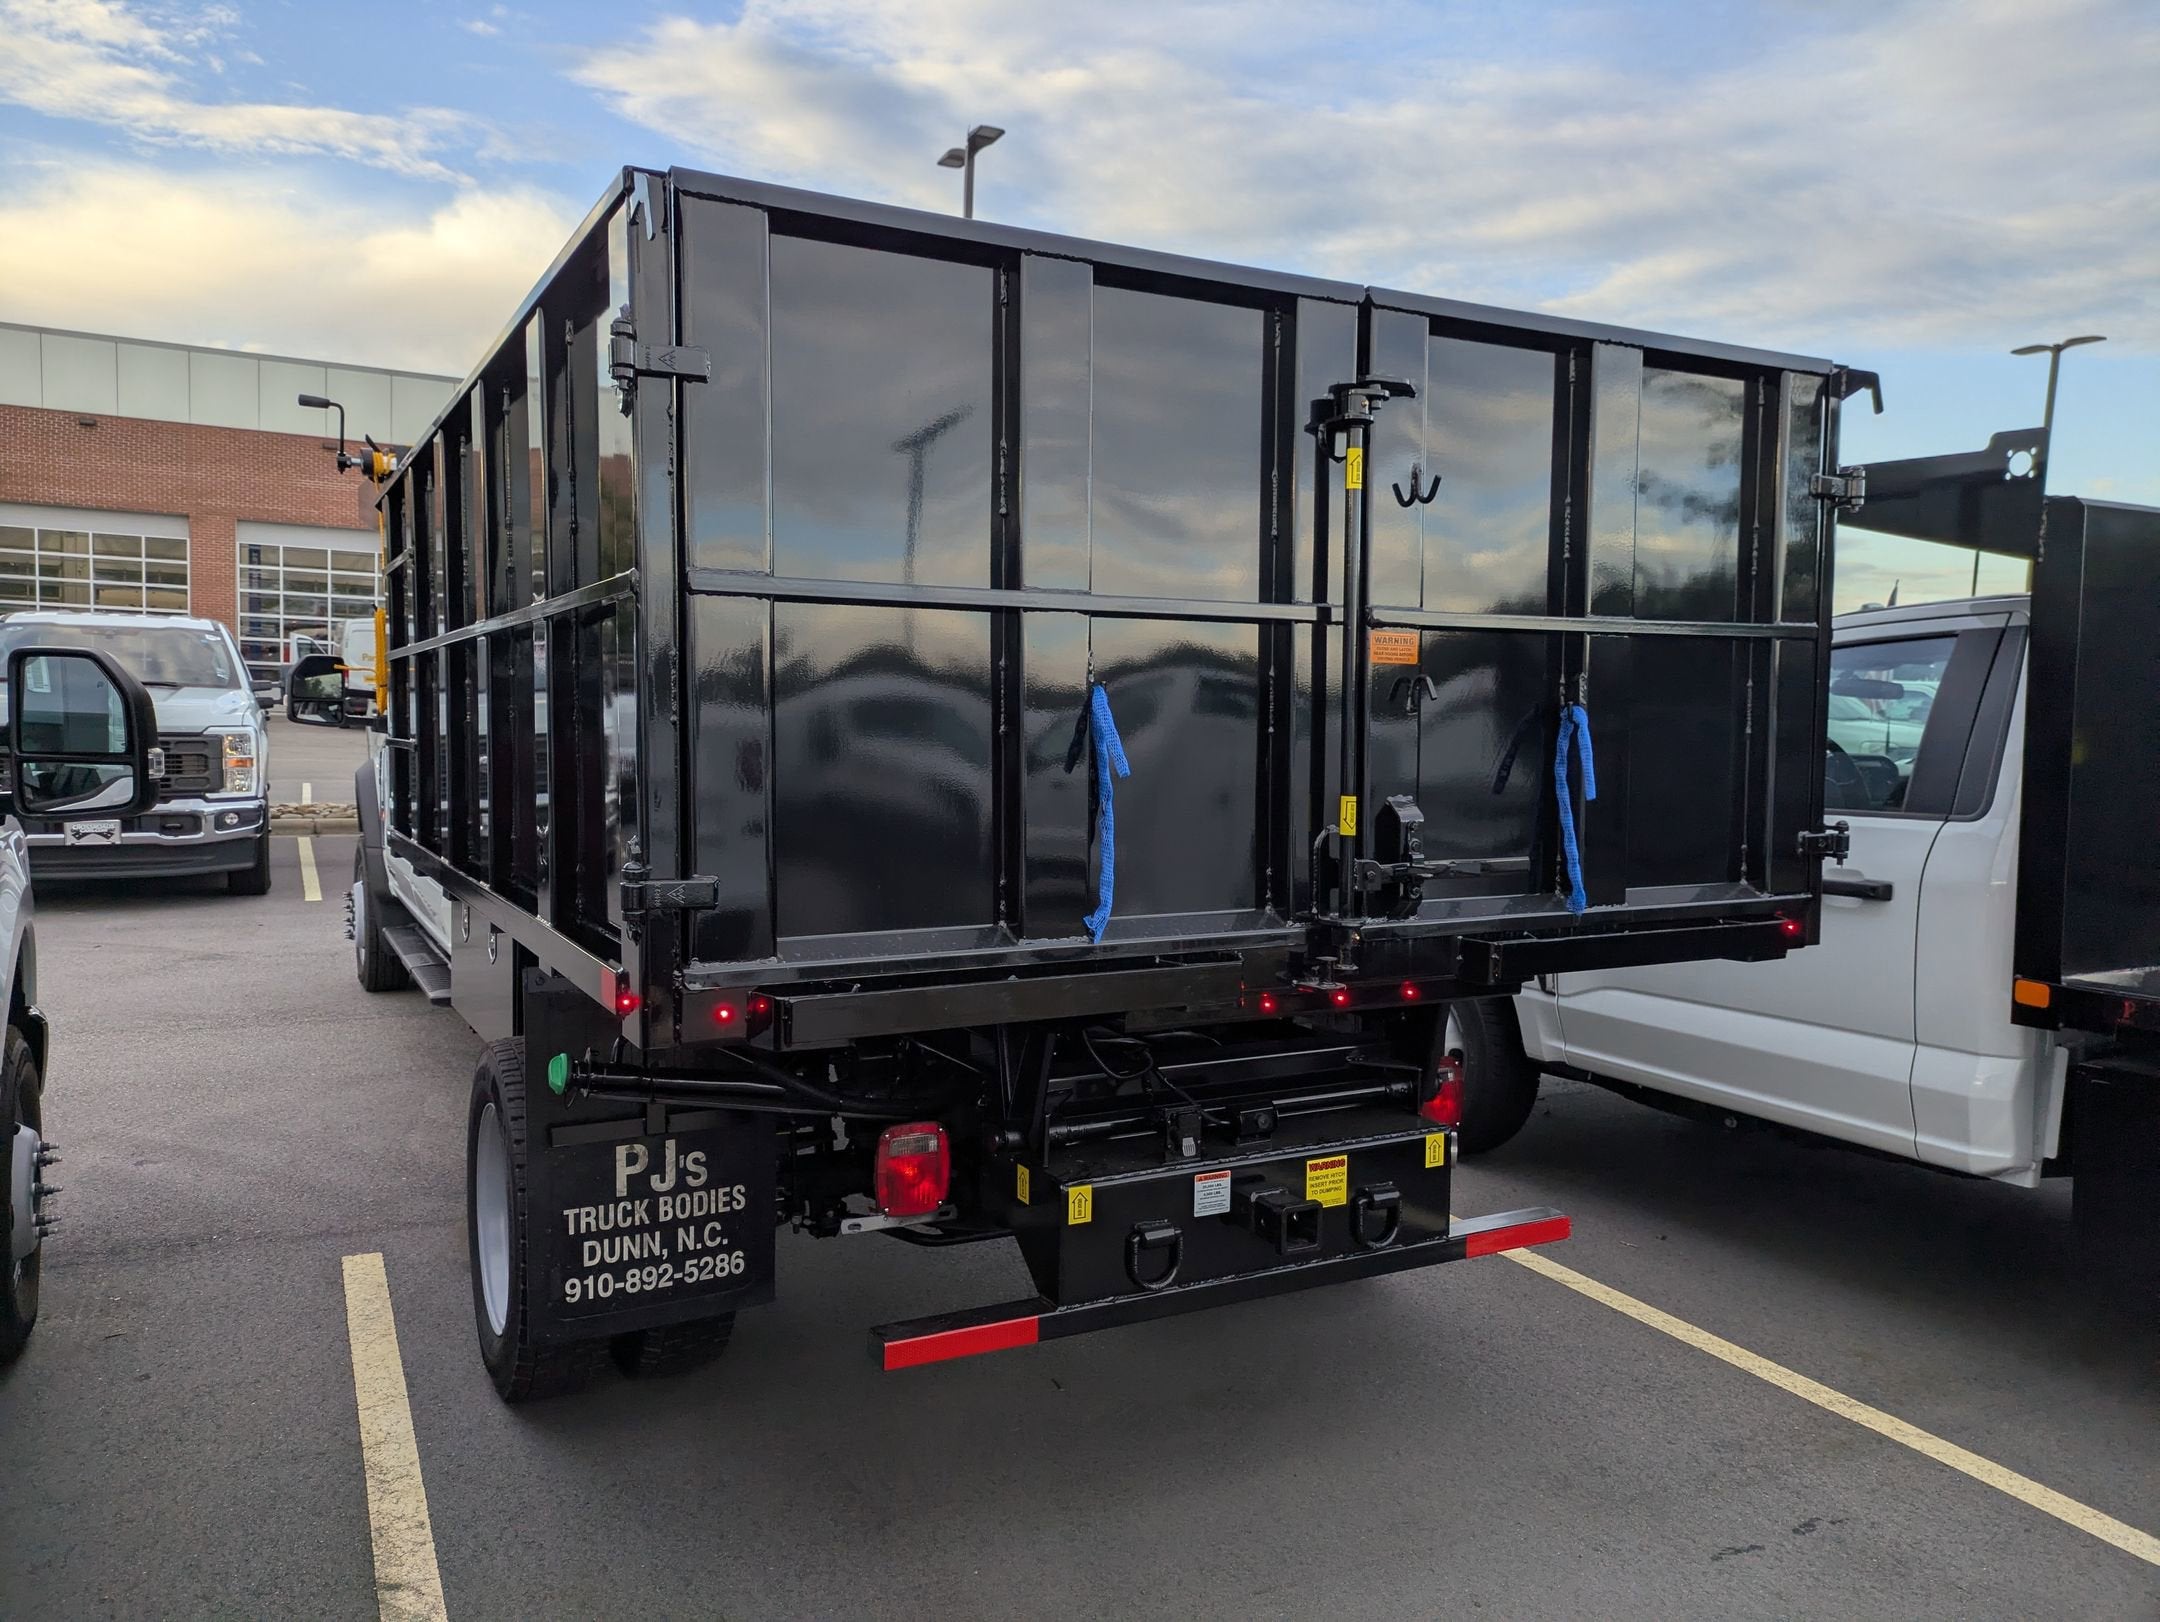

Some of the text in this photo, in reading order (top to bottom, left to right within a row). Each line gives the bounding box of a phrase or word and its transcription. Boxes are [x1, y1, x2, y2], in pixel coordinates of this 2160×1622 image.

[1375, 636, 1414, 645] WARNING
[1308, 1158, 1346, 1172] WARNING
[1309, 1173, 1329, 1181] REMOVE
[1319, 1185, 1343, 1194] DUMPING
[563, 1184, 746, 1235] TRUCK BODIES
[583, 1221, 728, 1267] DUNN, N.C.
[564, 1250, 745, 1303] 910-892-5286
